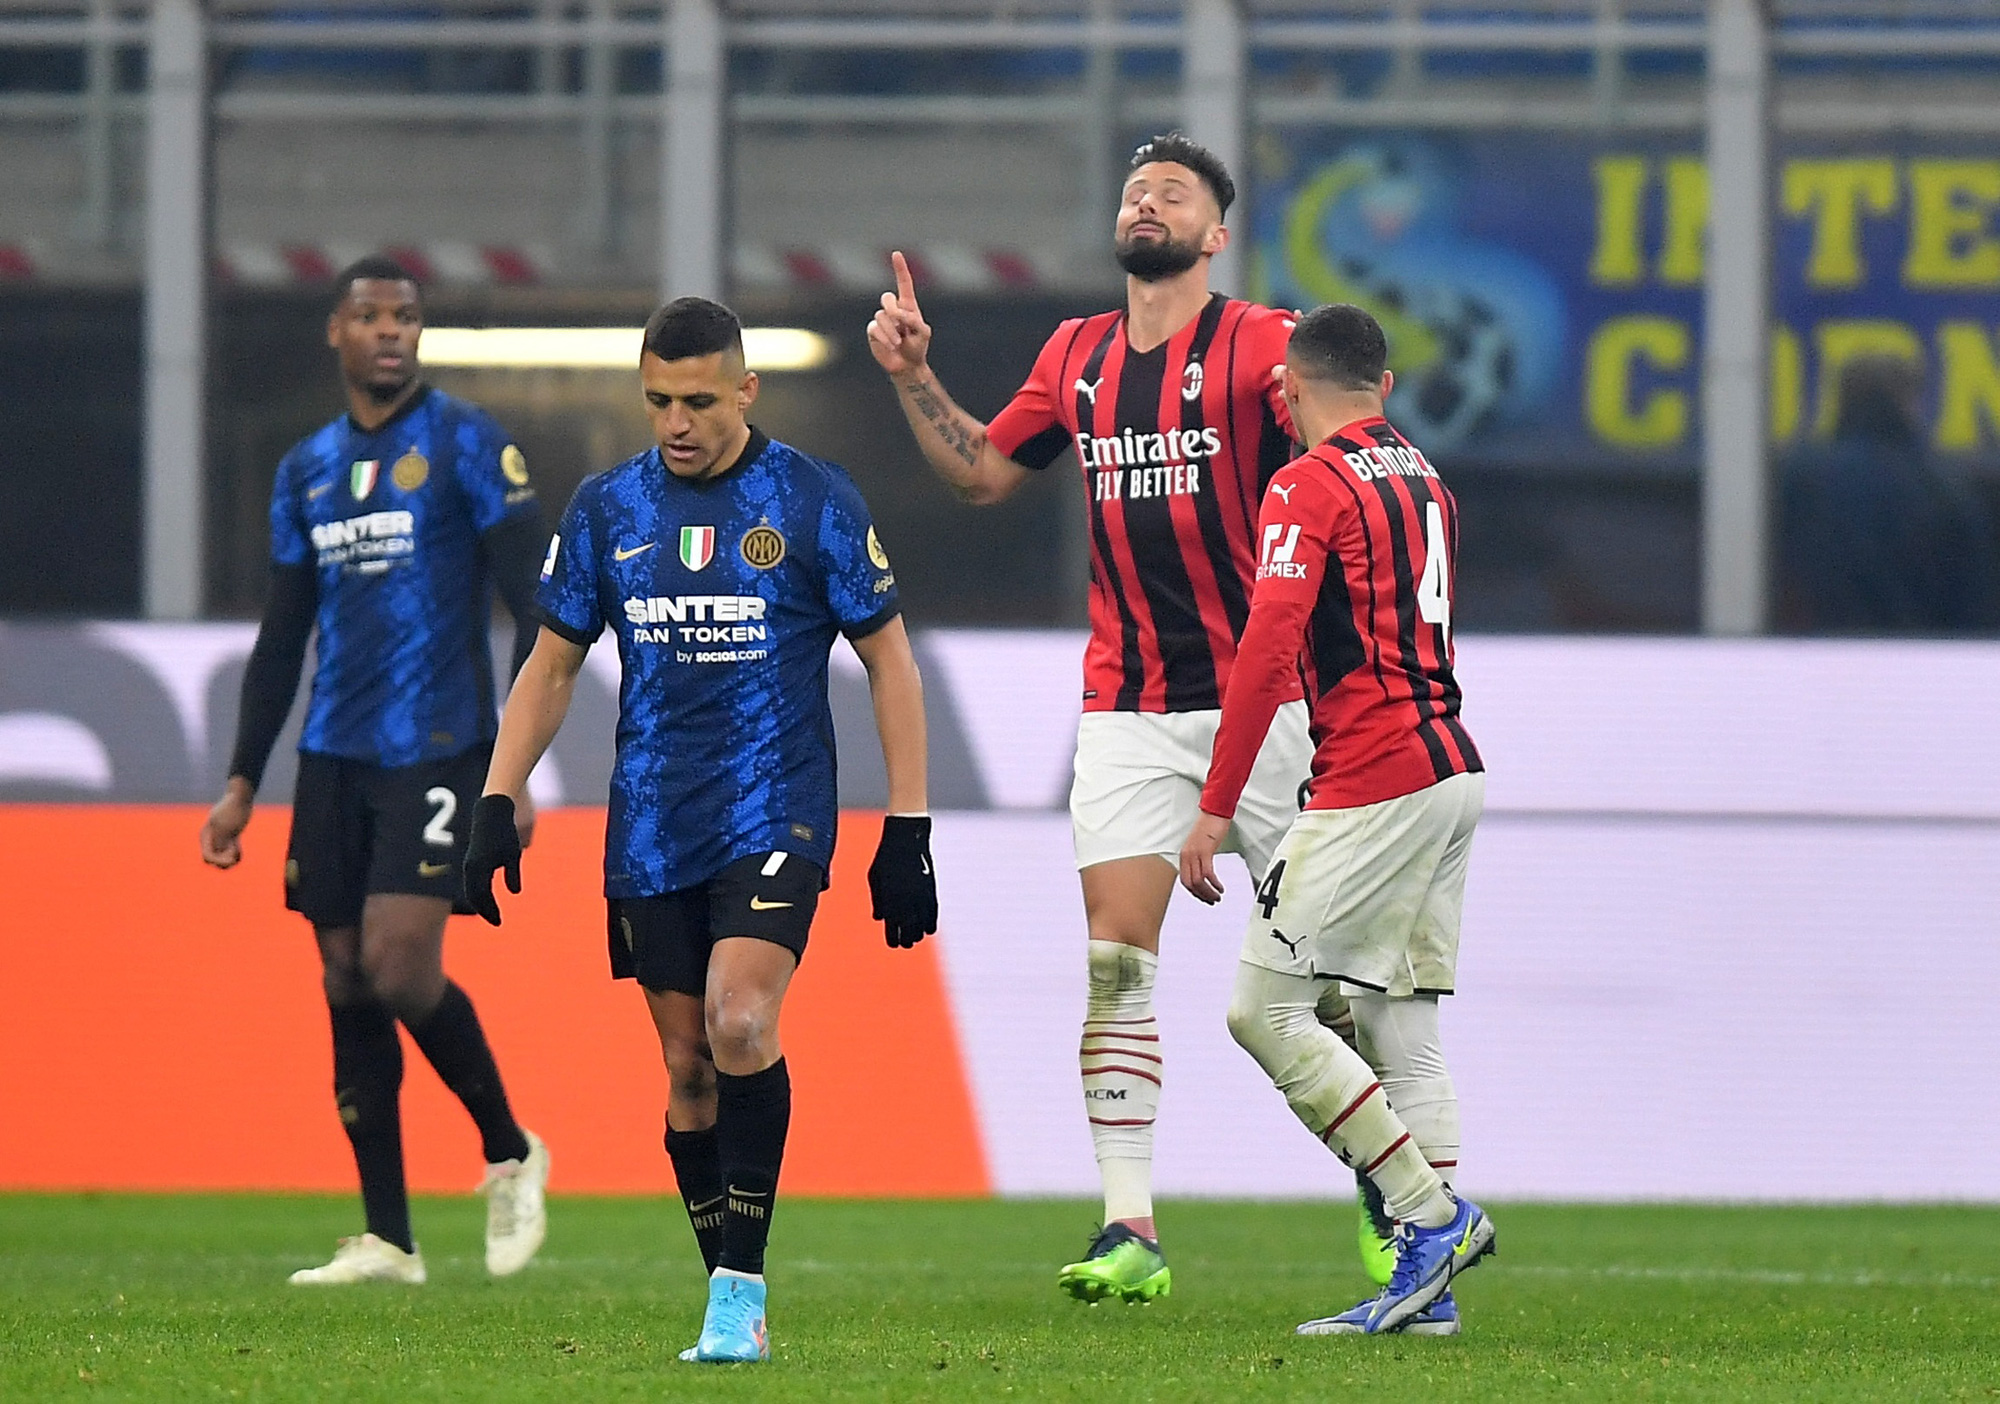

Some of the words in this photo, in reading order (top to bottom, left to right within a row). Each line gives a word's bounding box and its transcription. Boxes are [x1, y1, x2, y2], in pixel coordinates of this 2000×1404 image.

[1075, 427, 1222, 468] Emirates
[1096, 470, 1124, 501] FLY
[1130, 464, 1200, 499] BETTER
[1417, 501, 1450, 660] 4
[624, 596, 767, 626] $INTER
[634, 628, 669, 644] FAN
[678, 625, 767, 643] TOKEN
[676, 650, 693, 664] by
[695, 649, 767, 662] socios.com
[424, 786, 457, 846] 2
[1257, 859, 1287, 920] 4
[1085, 1088, 1128, 1100] ACM
[729, 1197, 765, 1219] INTER
